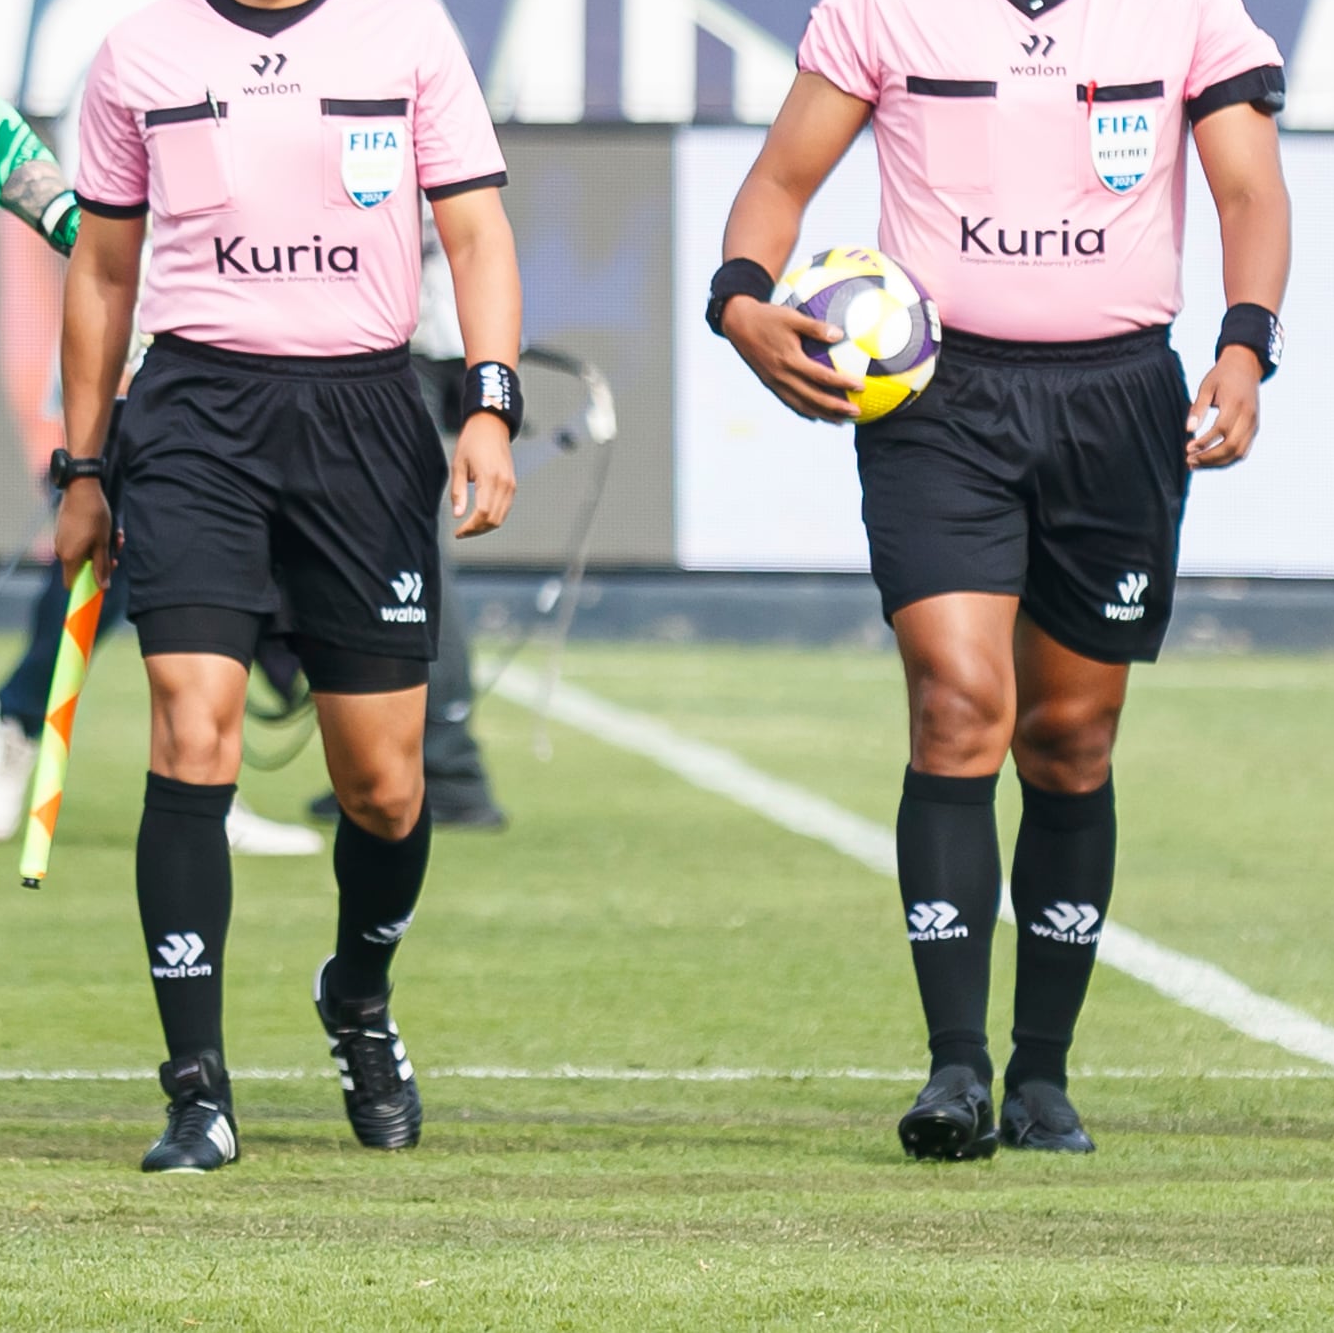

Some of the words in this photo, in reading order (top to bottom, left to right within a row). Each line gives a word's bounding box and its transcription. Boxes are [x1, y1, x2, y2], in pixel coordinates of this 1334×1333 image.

[1010, 63, 1067, 77] walon
[243, 82, 301, 96] walon
[1097, 115, 1149, 135] FIFA
[349, 131, 397, 151] FIFA
[960, 215, 1106, 258] Kuria
[214, 234, 360, 275] Kuria
[1030, 922, 1101, 945] walon
[152, 964, 212, 978] walon
